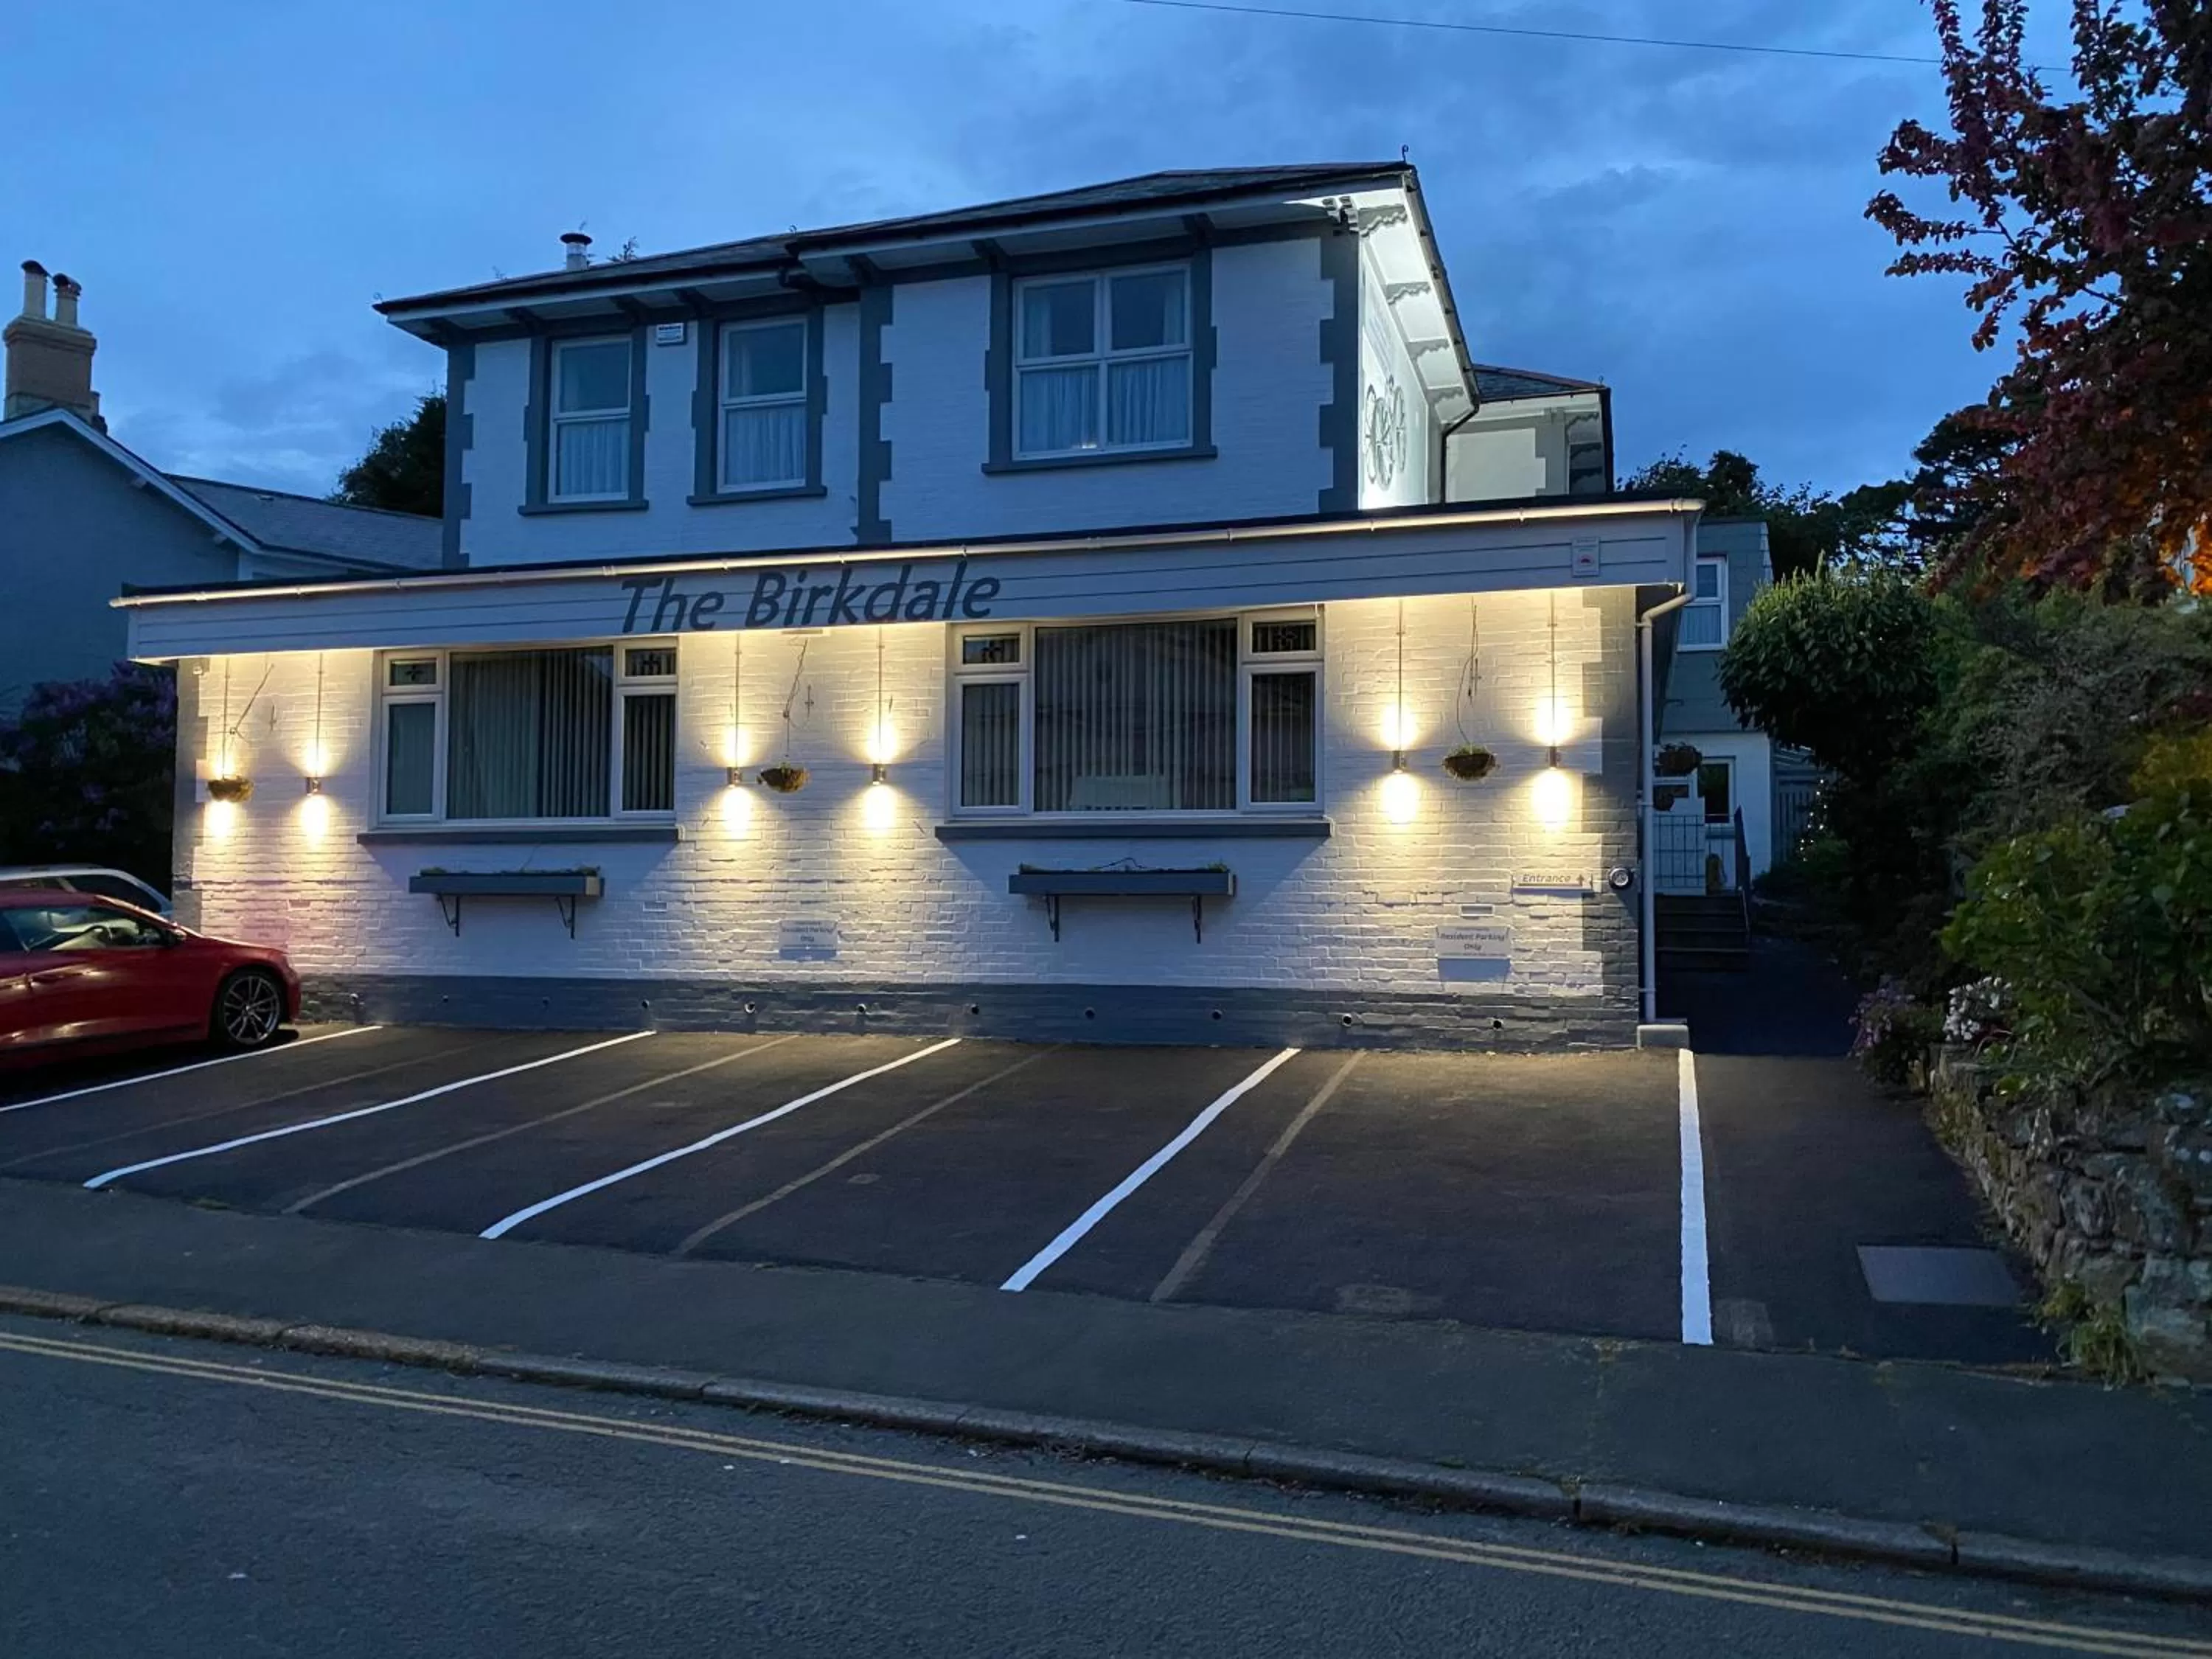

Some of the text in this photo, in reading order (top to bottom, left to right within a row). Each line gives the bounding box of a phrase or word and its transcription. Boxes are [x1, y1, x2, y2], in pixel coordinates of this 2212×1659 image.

[621, 560, 1001, 633] The Birkdale
[1523, 874, 1571, 883] Entrance
[1475, 933, 1505, 942] Parking
